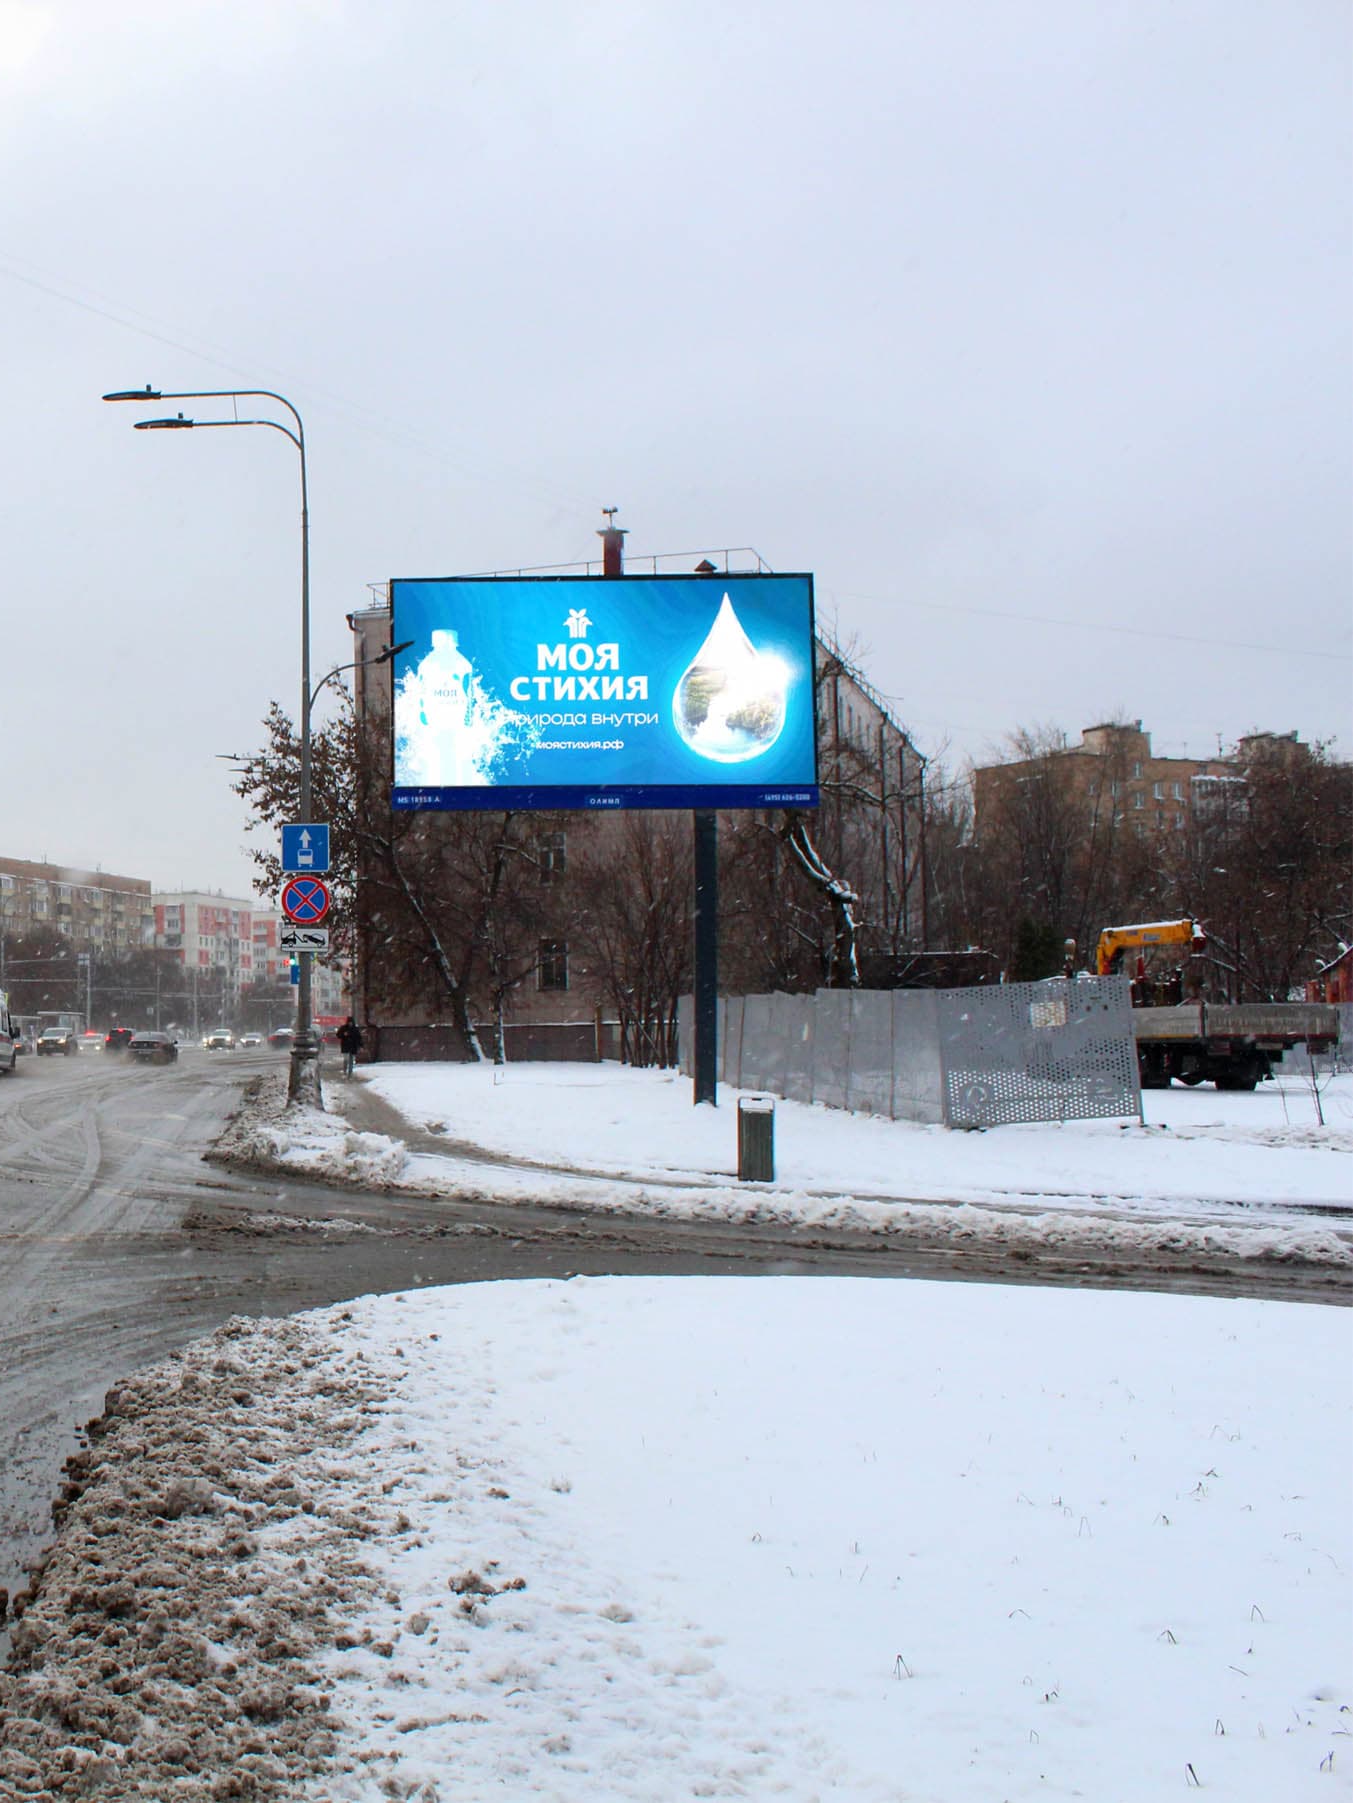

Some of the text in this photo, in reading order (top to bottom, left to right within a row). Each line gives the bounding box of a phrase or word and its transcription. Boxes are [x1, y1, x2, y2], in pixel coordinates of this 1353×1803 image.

[536, 643, 620, 671] МОЯ
[509, 675, 649, 701] СТИХИЯ
[591, 712, 659, 727] внутри
[535, 739, 625, 751] моястихия.рф
